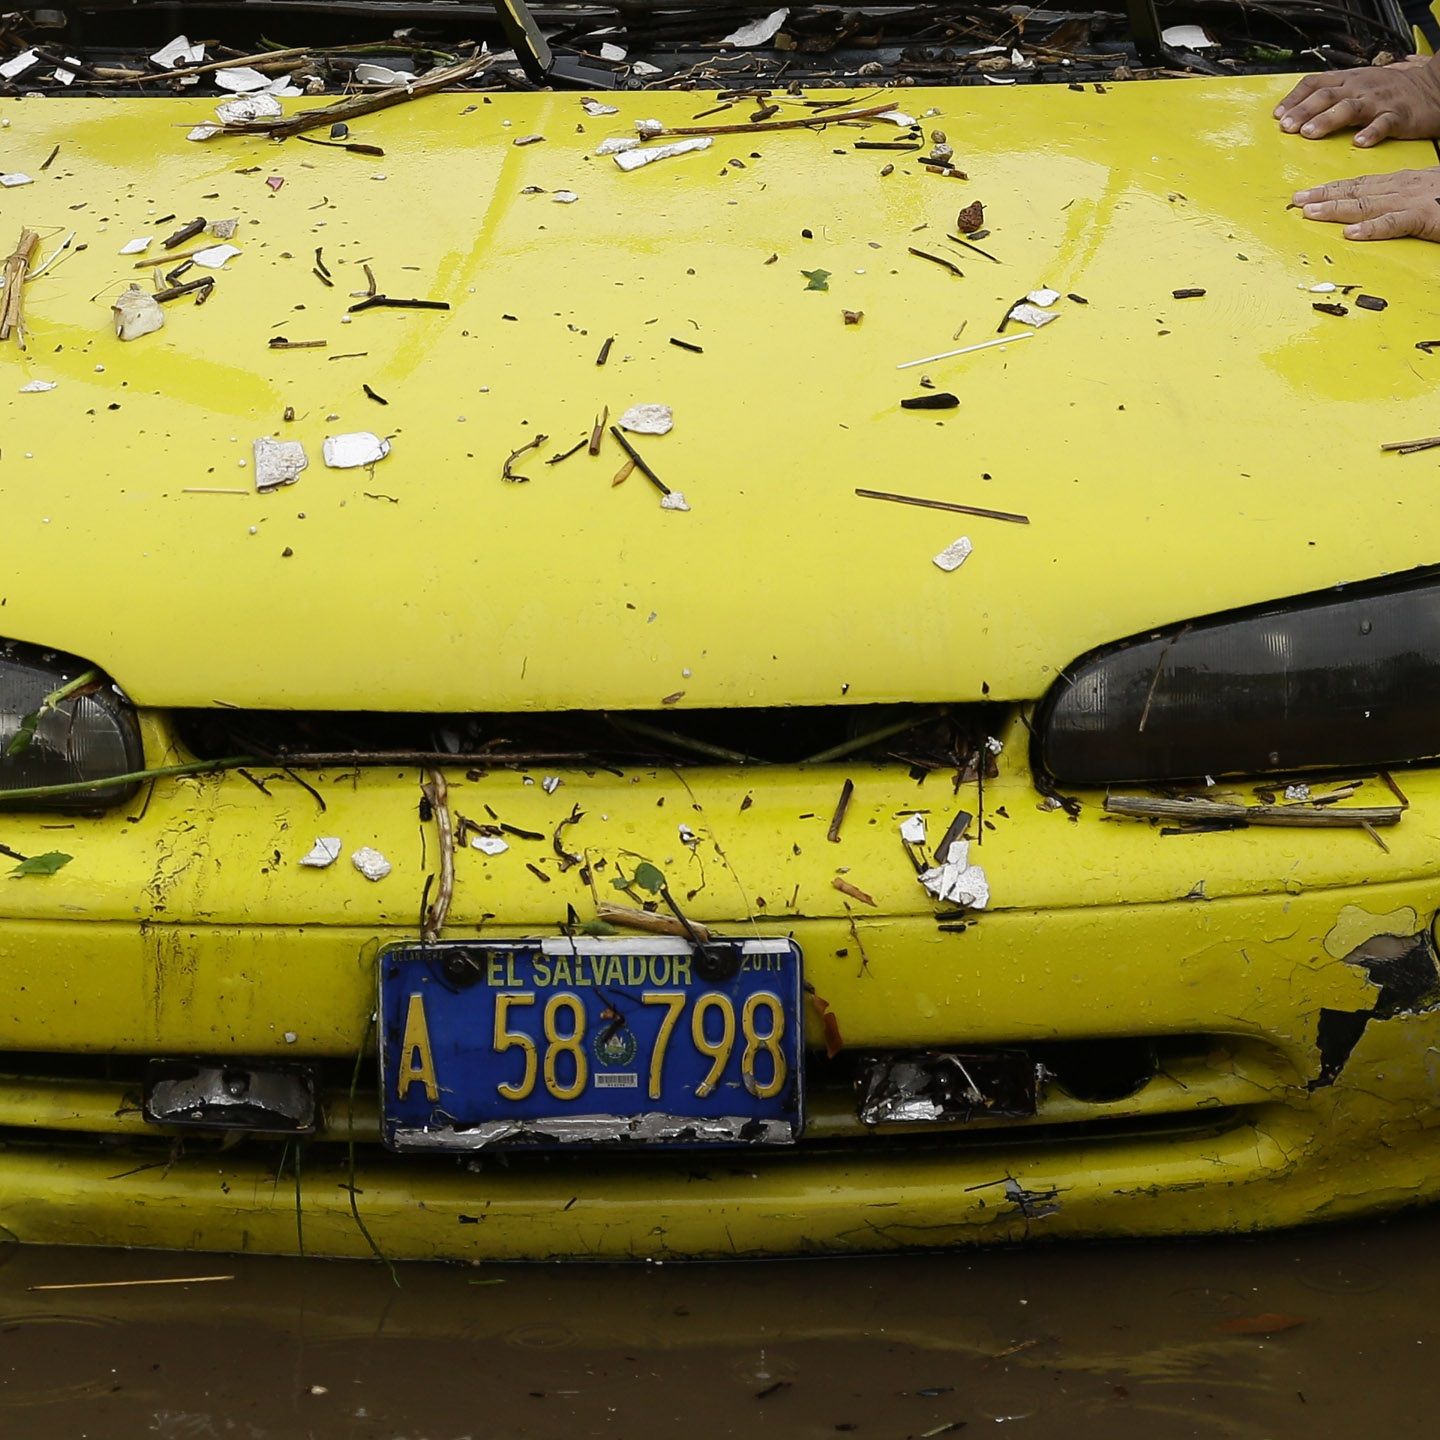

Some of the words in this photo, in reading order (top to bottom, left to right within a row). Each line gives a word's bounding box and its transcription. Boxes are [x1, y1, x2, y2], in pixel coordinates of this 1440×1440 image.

[487, 951, 523, 987] EL
[532, 953, 692, 987] SALVADOR
[397, 992, 439, 1102] A
[493, 992, 587, 1101] 58
[642, 992, 786, 1100] 798
